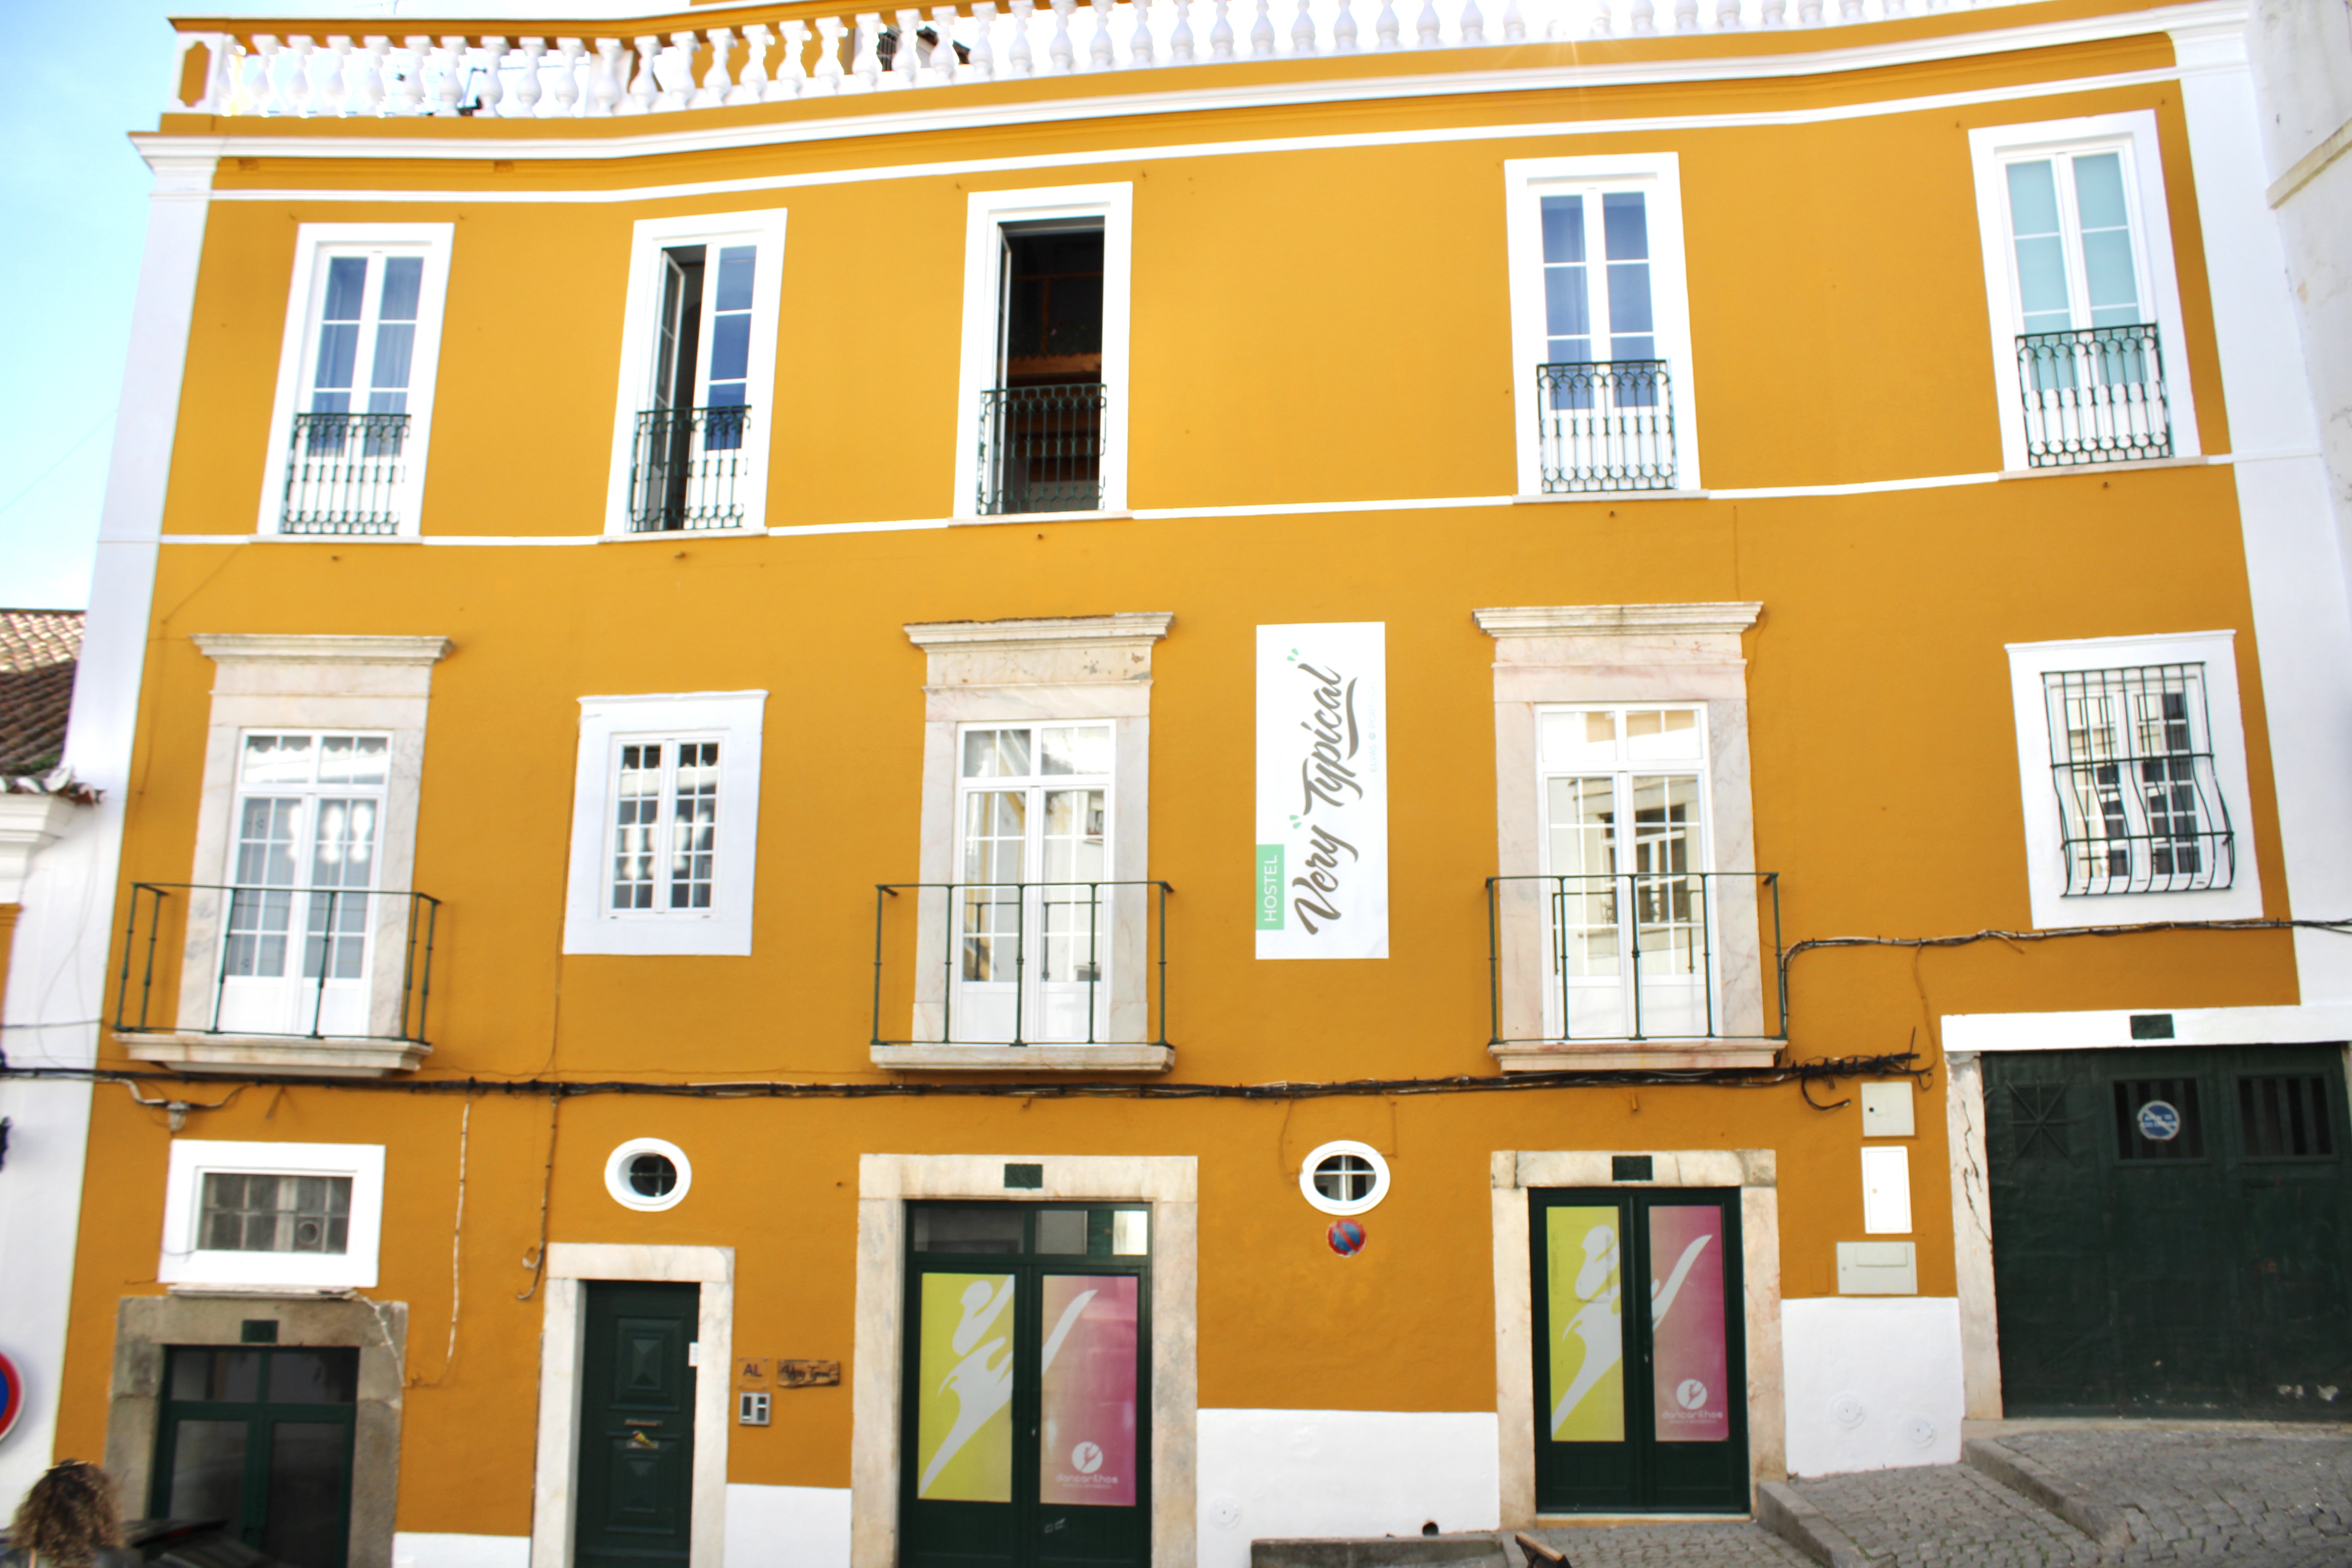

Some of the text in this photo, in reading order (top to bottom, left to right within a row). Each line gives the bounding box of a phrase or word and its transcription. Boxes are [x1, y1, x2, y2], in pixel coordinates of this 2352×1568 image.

[1369, 744, 1377, 773] ELVAS
[1292, 662, 1363, 935] Very Typical
[1264, 855, 1278, 922] HOSTEL
[742, 1363, 762, 1377] AL
